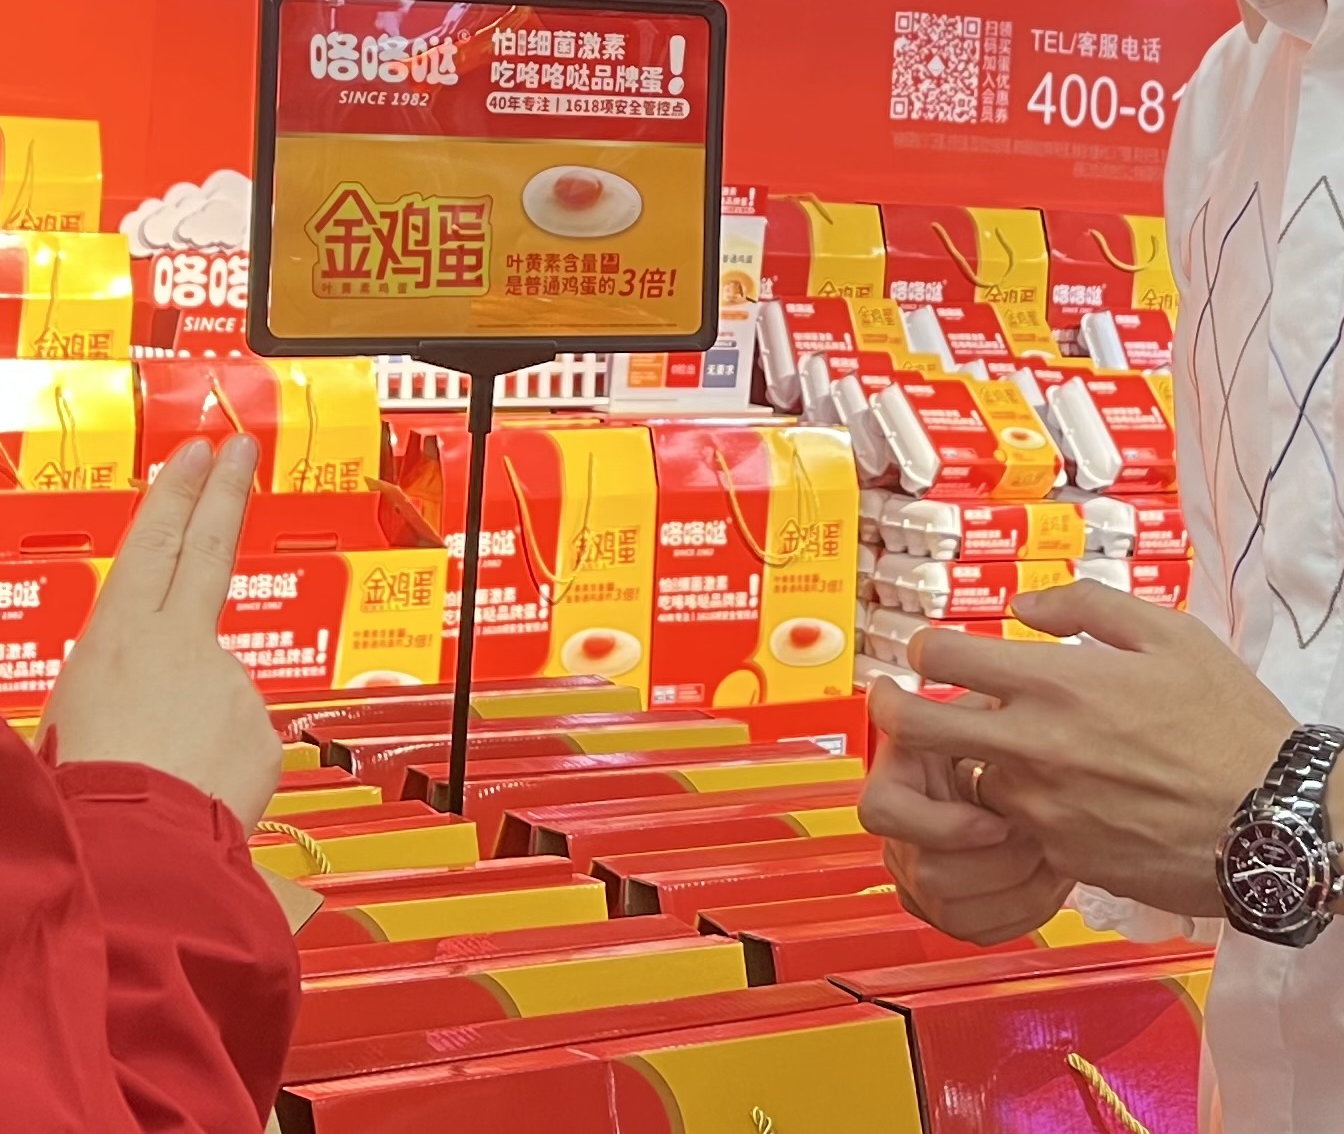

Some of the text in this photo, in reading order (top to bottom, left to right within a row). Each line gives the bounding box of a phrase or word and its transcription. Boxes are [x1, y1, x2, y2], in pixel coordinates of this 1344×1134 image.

[310, 31, 459, 86] 咯咯哒
[1031, 28, 1162, 63] TEL/客服电话
[338, 90, 430, 107] SINCE 1982
[489, 96, 685, 117] 40年专注 1618项安全管控点
[314, 189, 486, 290] 金鸡蛋
[183, 316, 237, 333] SINCE
